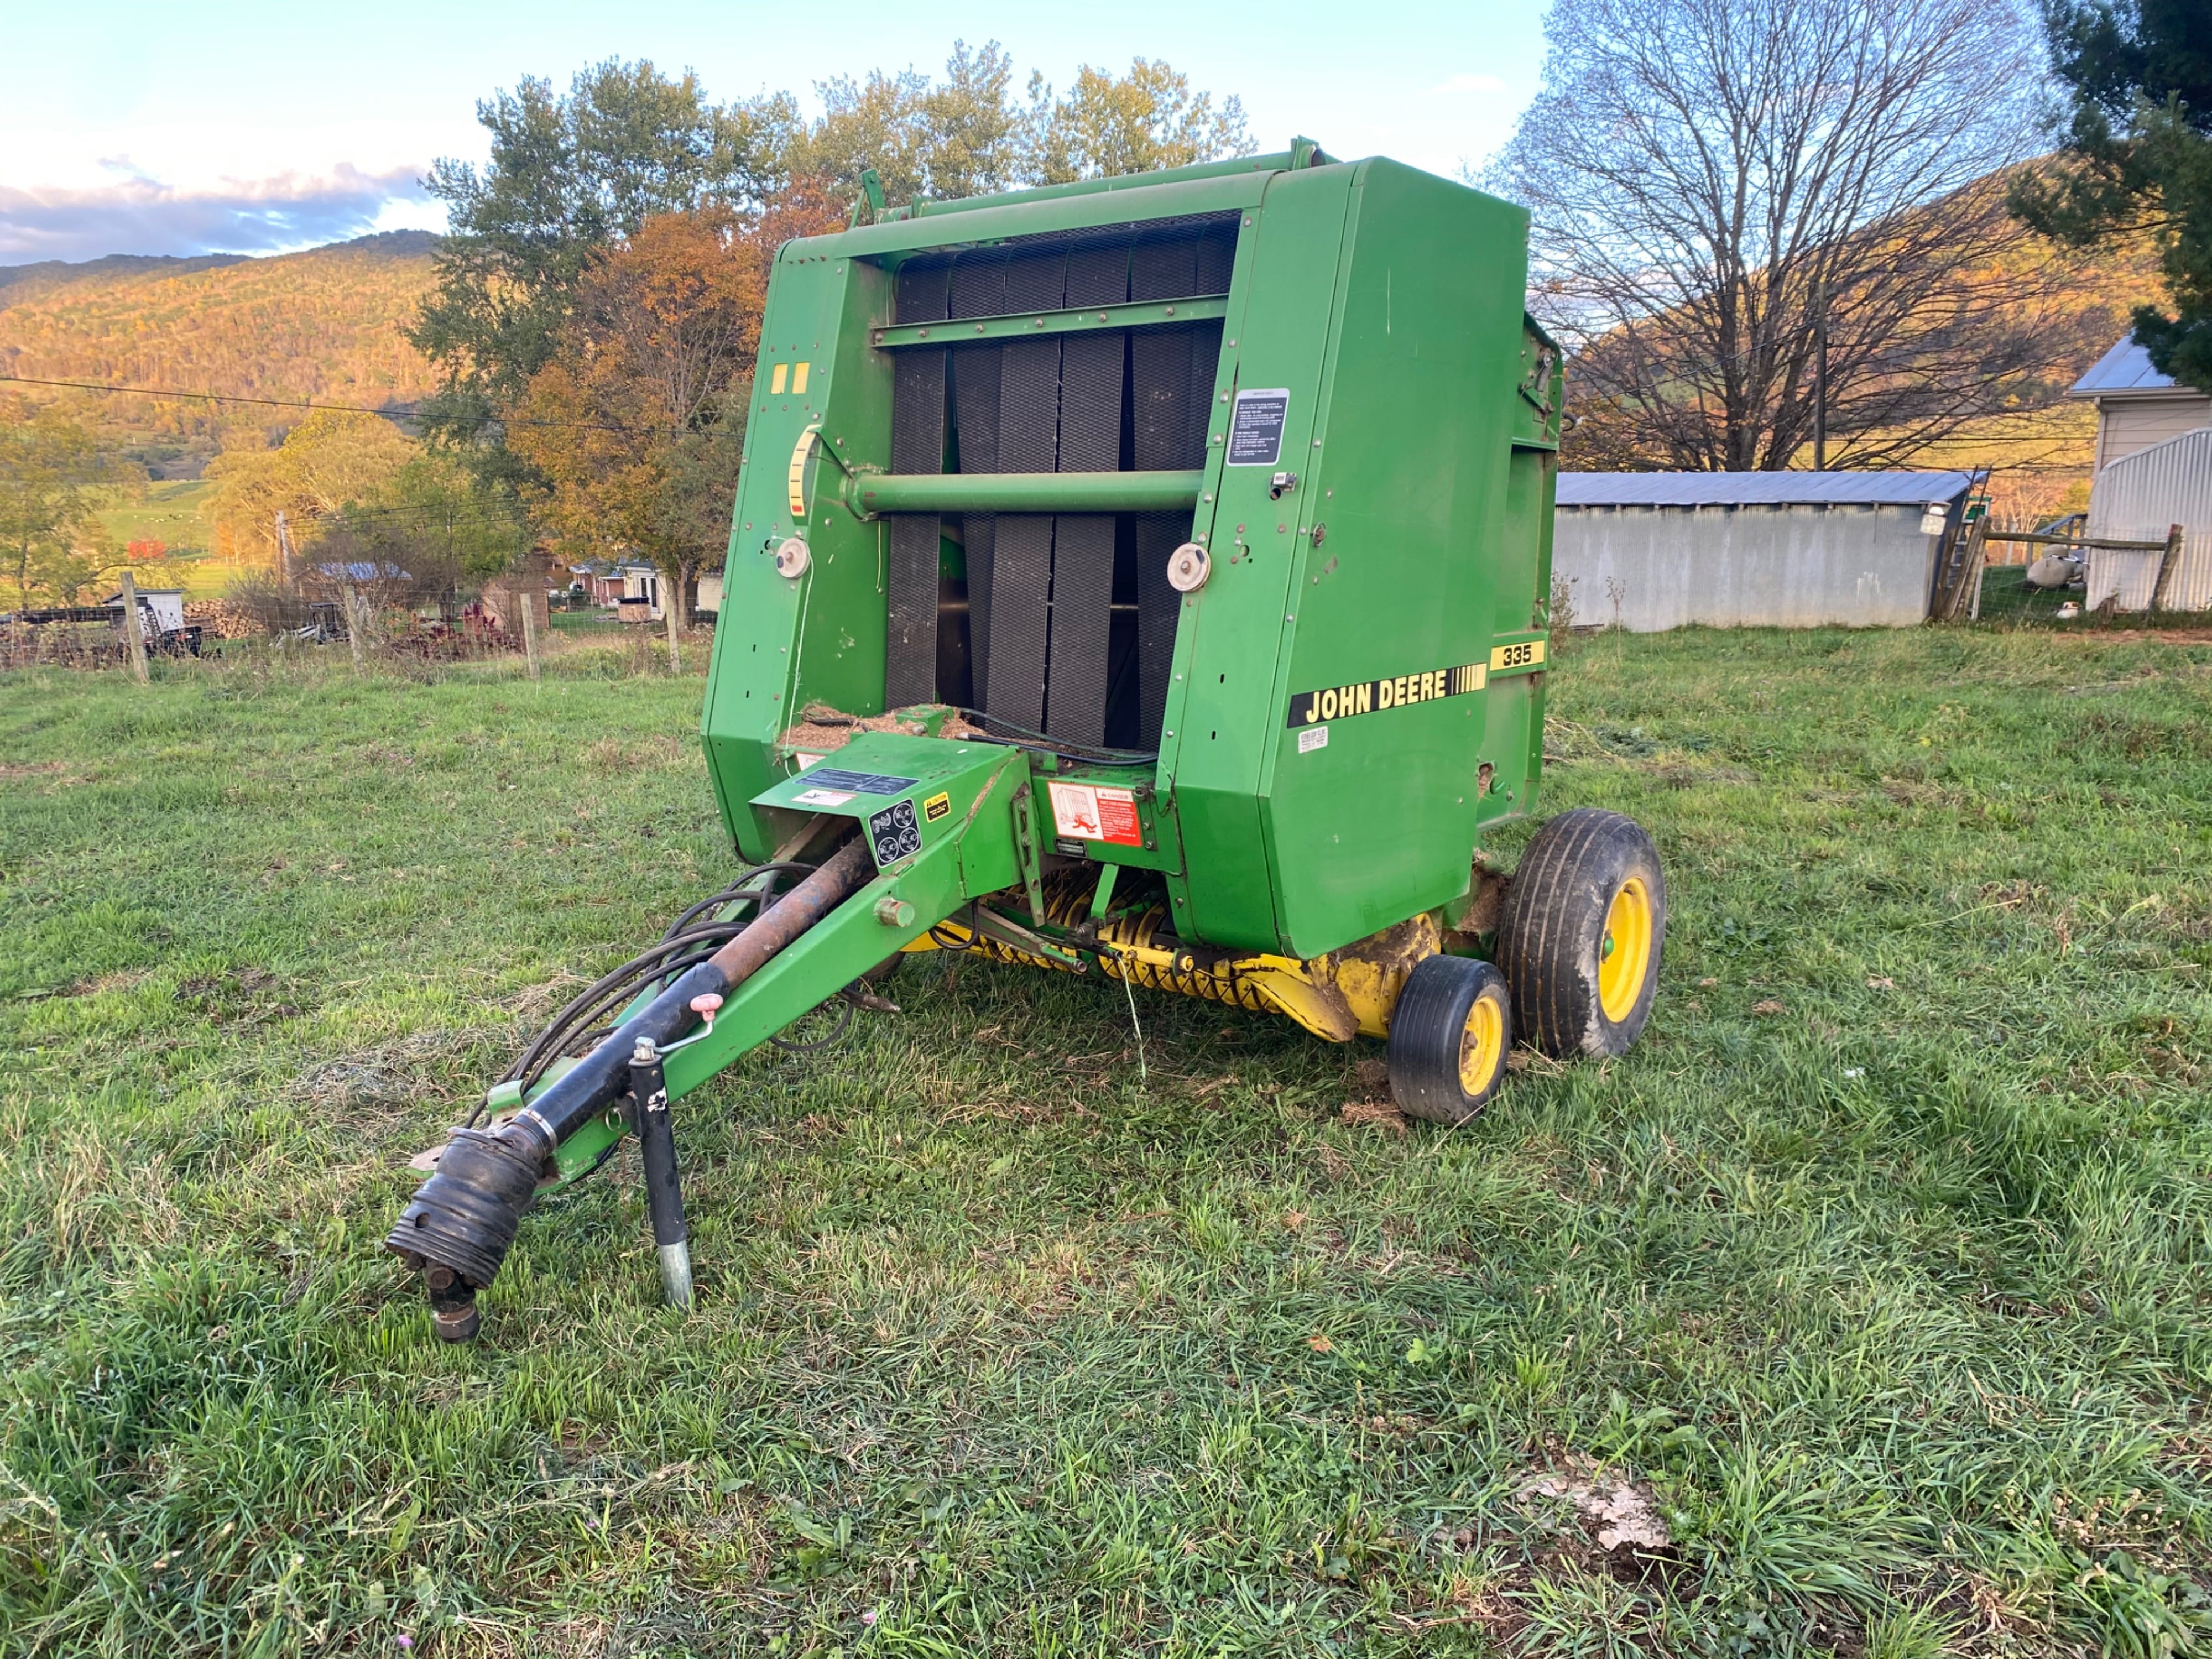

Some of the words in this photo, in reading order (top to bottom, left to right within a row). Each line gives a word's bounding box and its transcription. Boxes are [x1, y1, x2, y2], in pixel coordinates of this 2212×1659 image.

[1503, 644, 1531, 667] 335
[1306, 682, 1371, 723] JOHN
[1379, 670, 1447, 709] DEERE
